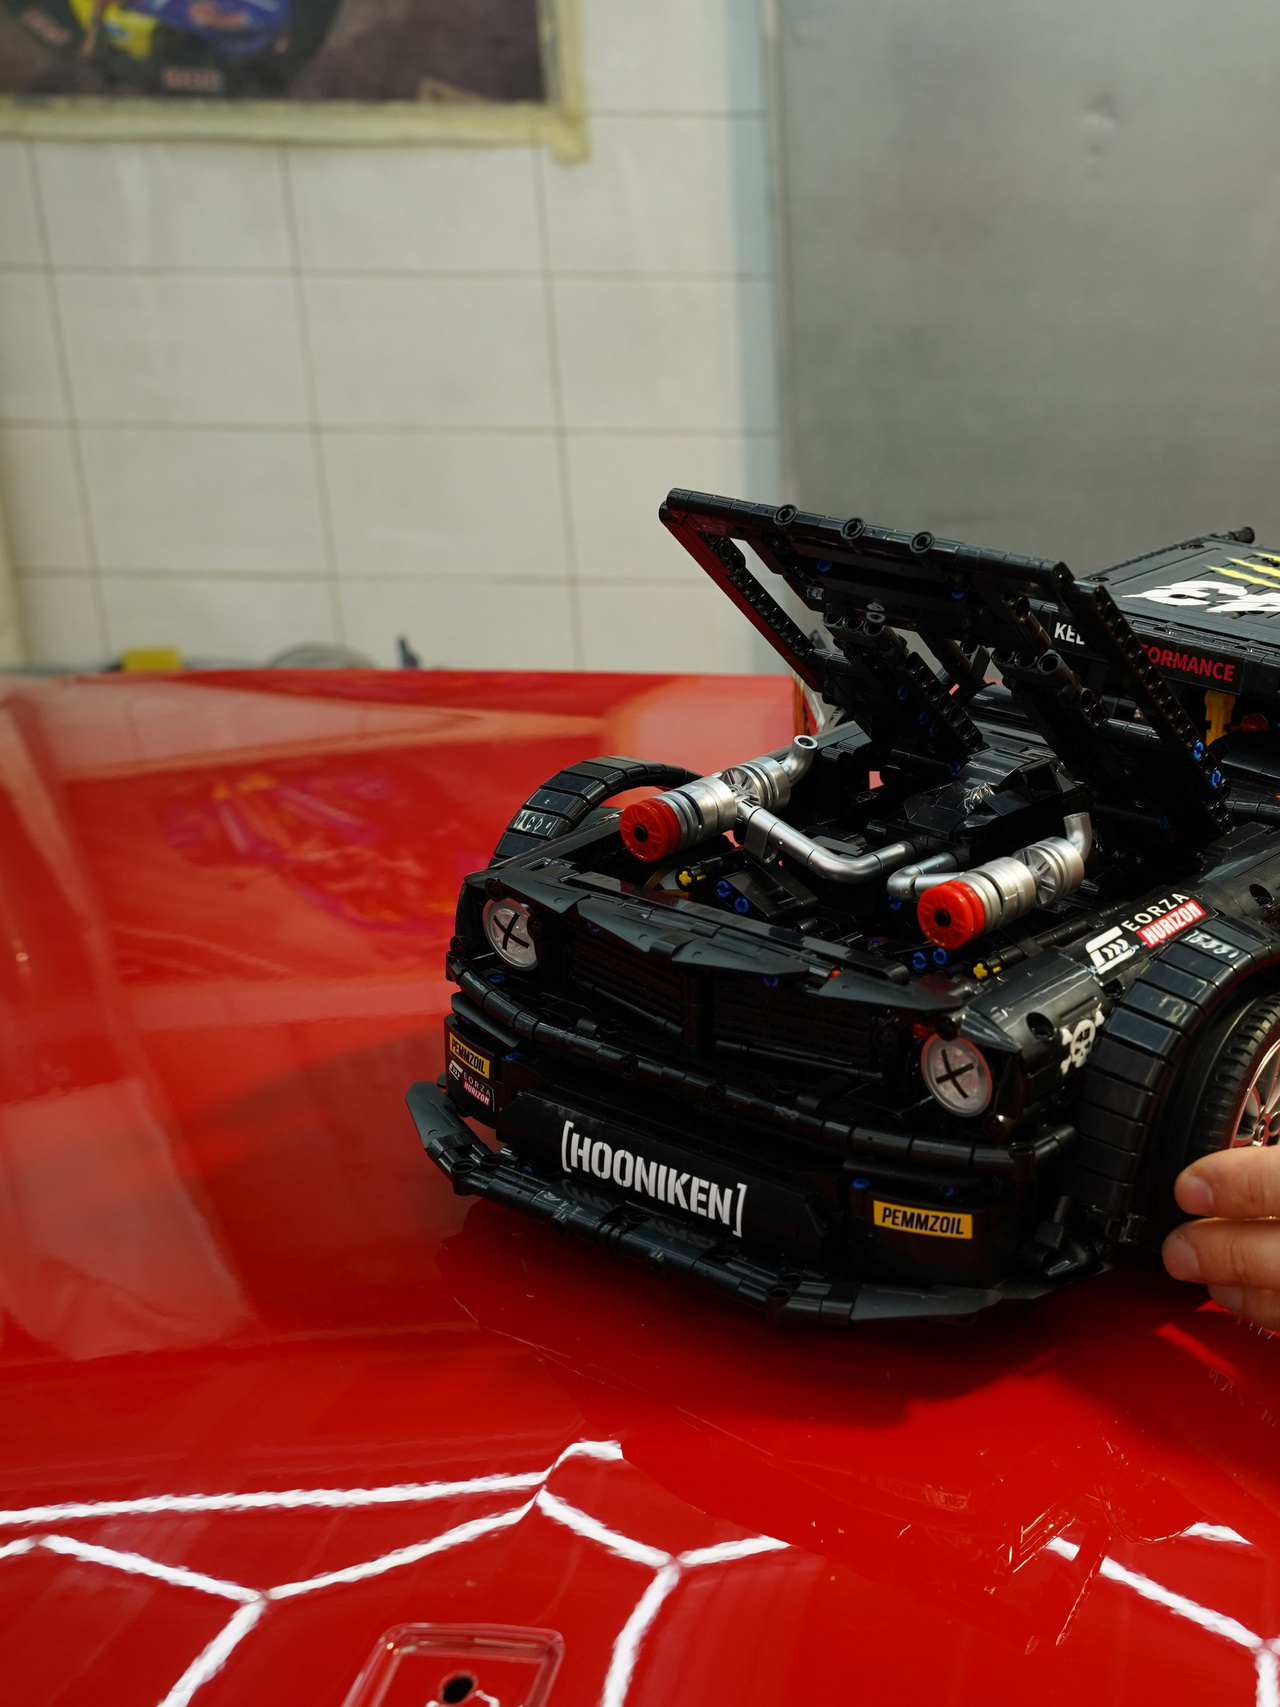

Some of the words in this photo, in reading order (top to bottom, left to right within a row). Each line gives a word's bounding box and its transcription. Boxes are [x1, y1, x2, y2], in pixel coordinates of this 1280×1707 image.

[1121, 891, 1190, 933] EORZA
[1141, 901, 1203, 945] HURIZON
[451, 1038, 486, 1075] PEMMZOIL
[463, 1071, 492, 1098] EORZA
[463, 1082, 490, 1106] HURIZON
[560, 1119, 747, 1238] [HOONIKEN]
[880, 1205, 965, 1236] PEMMZOIL
